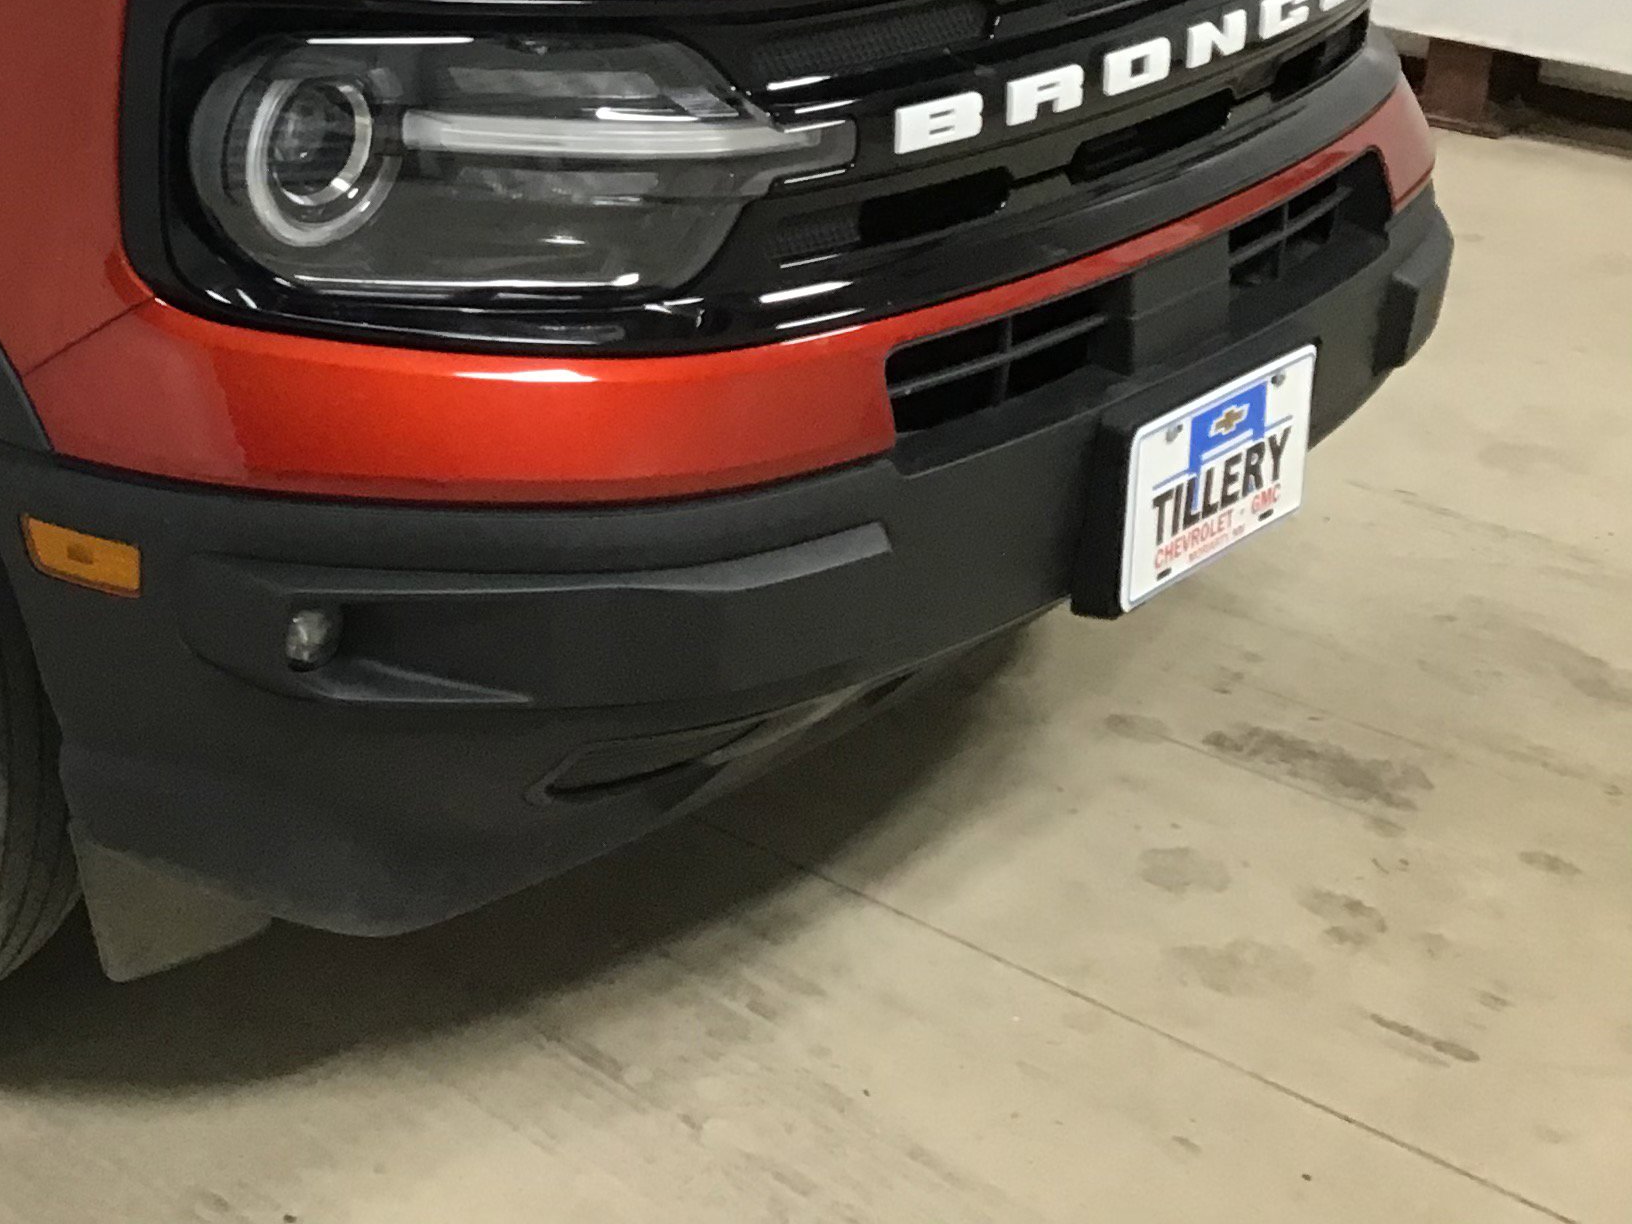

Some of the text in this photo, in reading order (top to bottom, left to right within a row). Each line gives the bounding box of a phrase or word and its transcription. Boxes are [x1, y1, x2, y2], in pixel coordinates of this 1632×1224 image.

[1152, 425, 1292, 546] TILLERY
[1154, 508, 1234, 569] CHEVROLET
[1251, 483, 1281, 514] GMC
